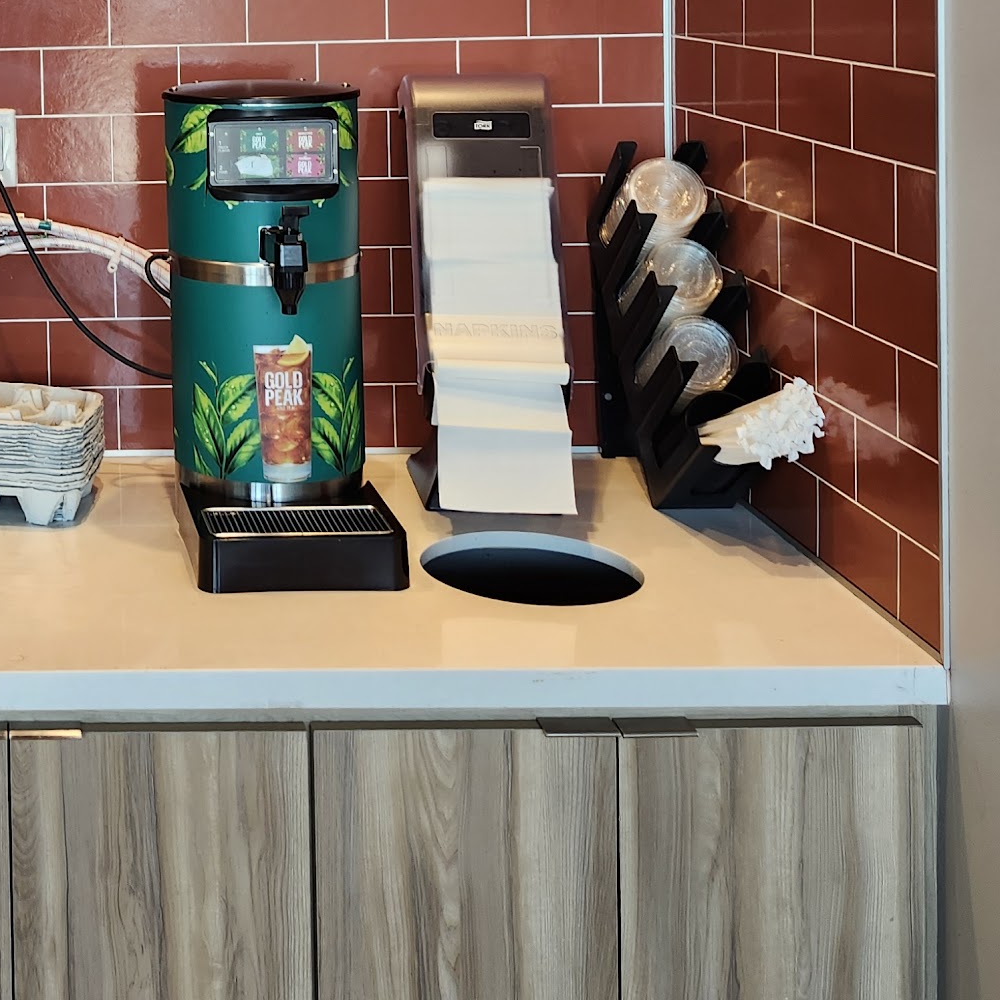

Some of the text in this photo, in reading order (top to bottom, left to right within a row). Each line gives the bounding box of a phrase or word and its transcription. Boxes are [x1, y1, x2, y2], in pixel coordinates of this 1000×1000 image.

[433, 322, 558, 340] NAPKINS
[264, 371, 303, 390] GOLD
[264, 389, 304, 407] PEAK
